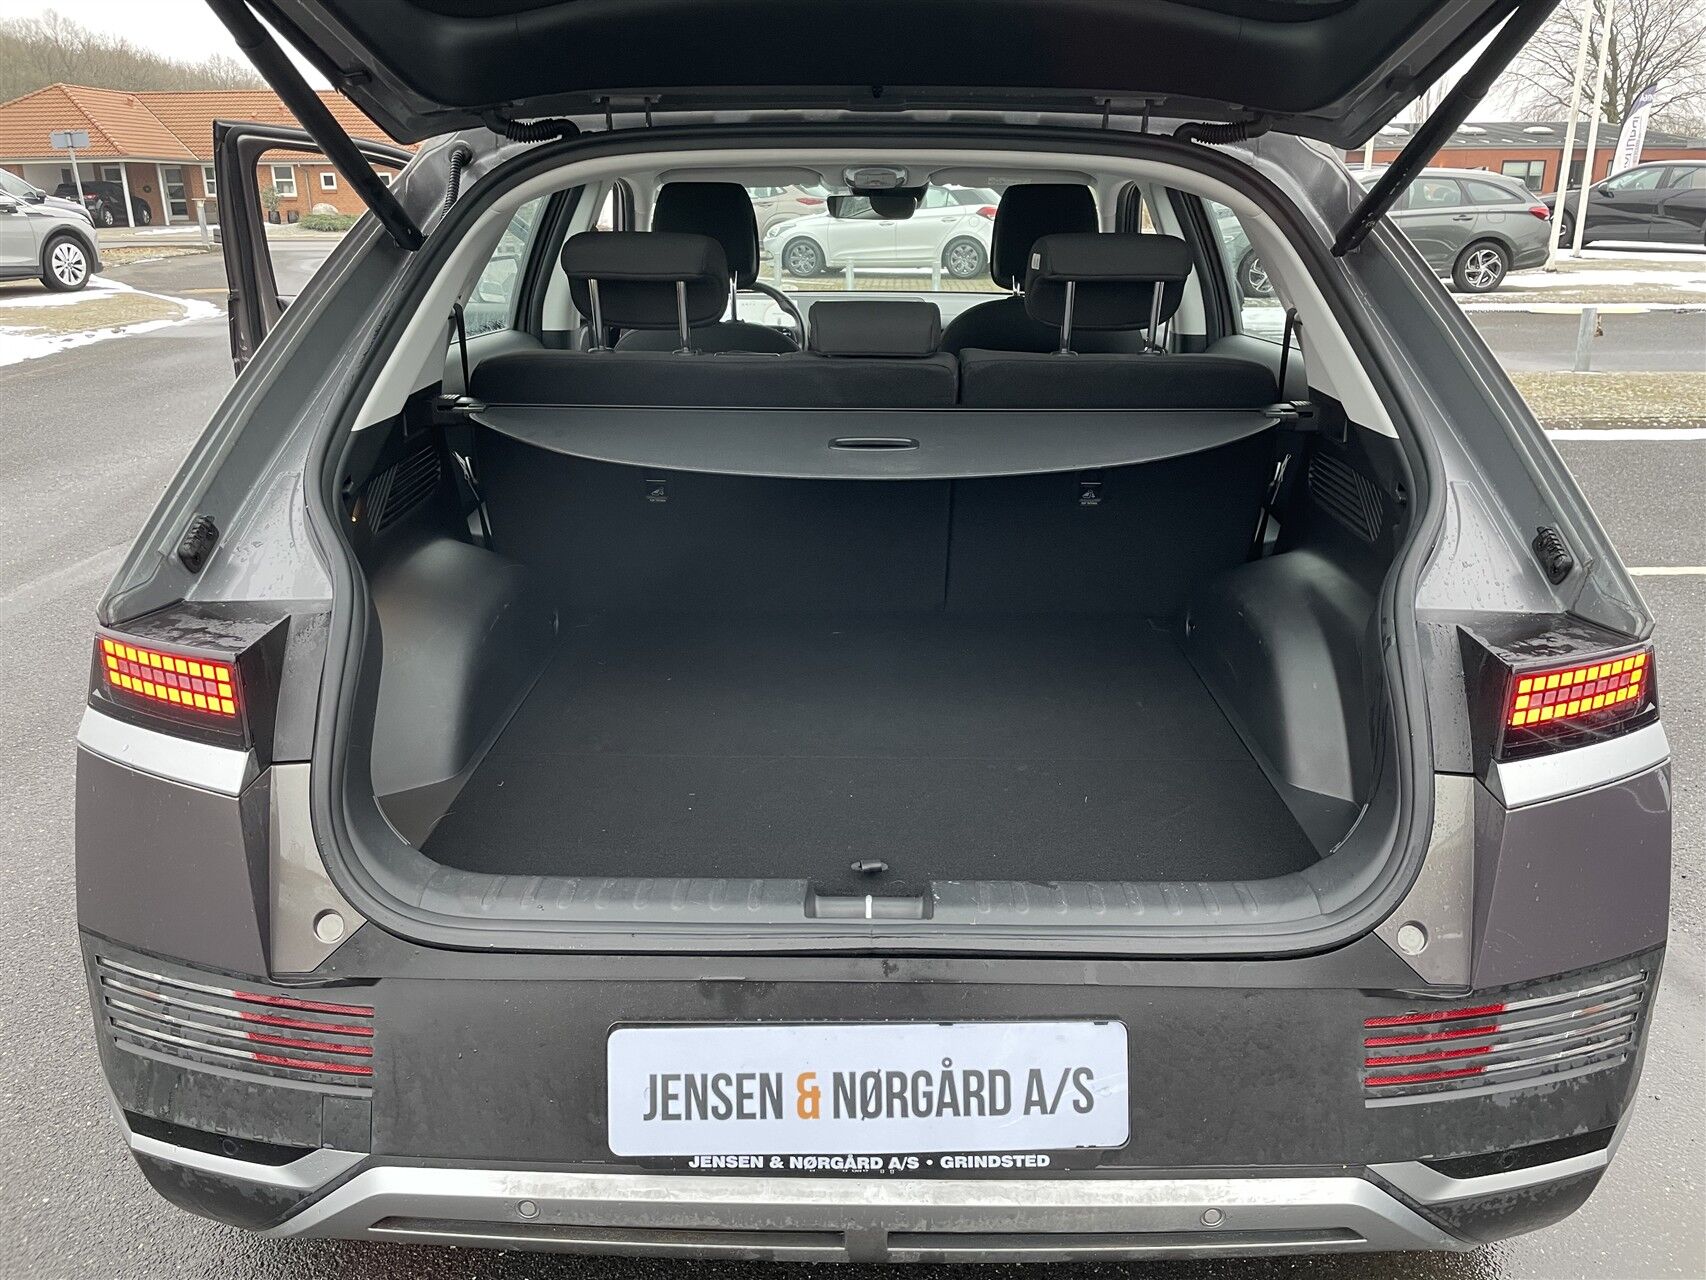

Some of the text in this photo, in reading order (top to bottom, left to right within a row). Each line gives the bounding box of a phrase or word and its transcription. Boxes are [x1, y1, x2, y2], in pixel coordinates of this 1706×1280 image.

[643, 1057, 1095, 1121] JENSEN & NØRGÅRD A/S
[688, 1155, 764, 1169] JENSEN
[769, 1156, 784, 1169] &
[789, 1153, 884, 1170] NØRGÅRD
[888, 1156, 920, 1171] A/S
[940, 1154, 1051, 1169] GRINDSTED
